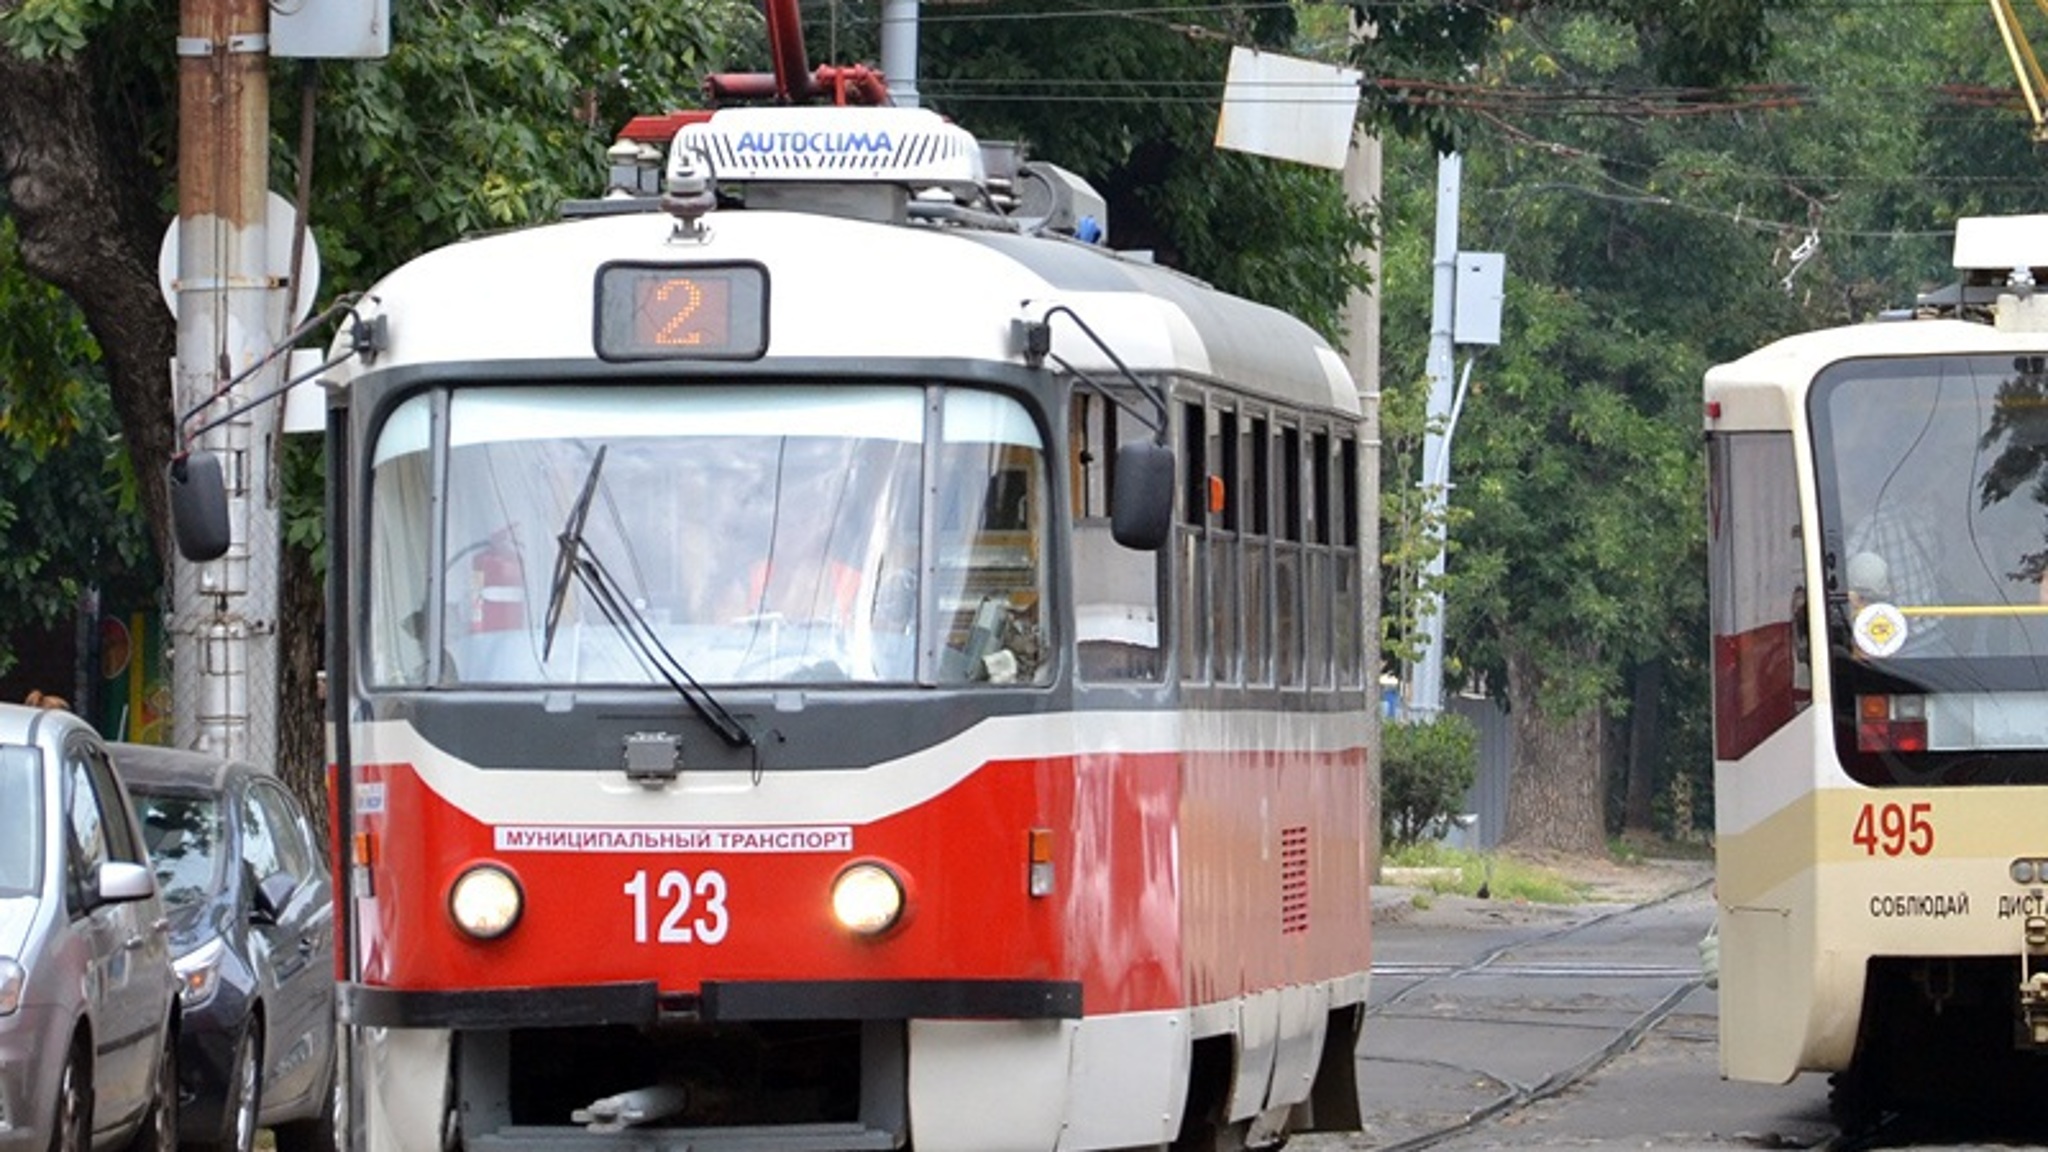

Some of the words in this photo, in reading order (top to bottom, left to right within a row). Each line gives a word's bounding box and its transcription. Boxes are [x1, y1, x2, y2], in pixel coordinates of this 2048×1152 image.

[737, 132, 893, 153] AUTOCLIMA
[656, 278, 701, 344] 2
[506, 830, 711, 850] МУНИЦИПАЛЬНЫЙ
[720, 832, 850, 848] ТРАНСПОРТ
[1853, 803, 1934, 857] 495
[624, 870, 729, 943] 123
[1870, 892, 1969, 917] СОБЛЮДАЙ
